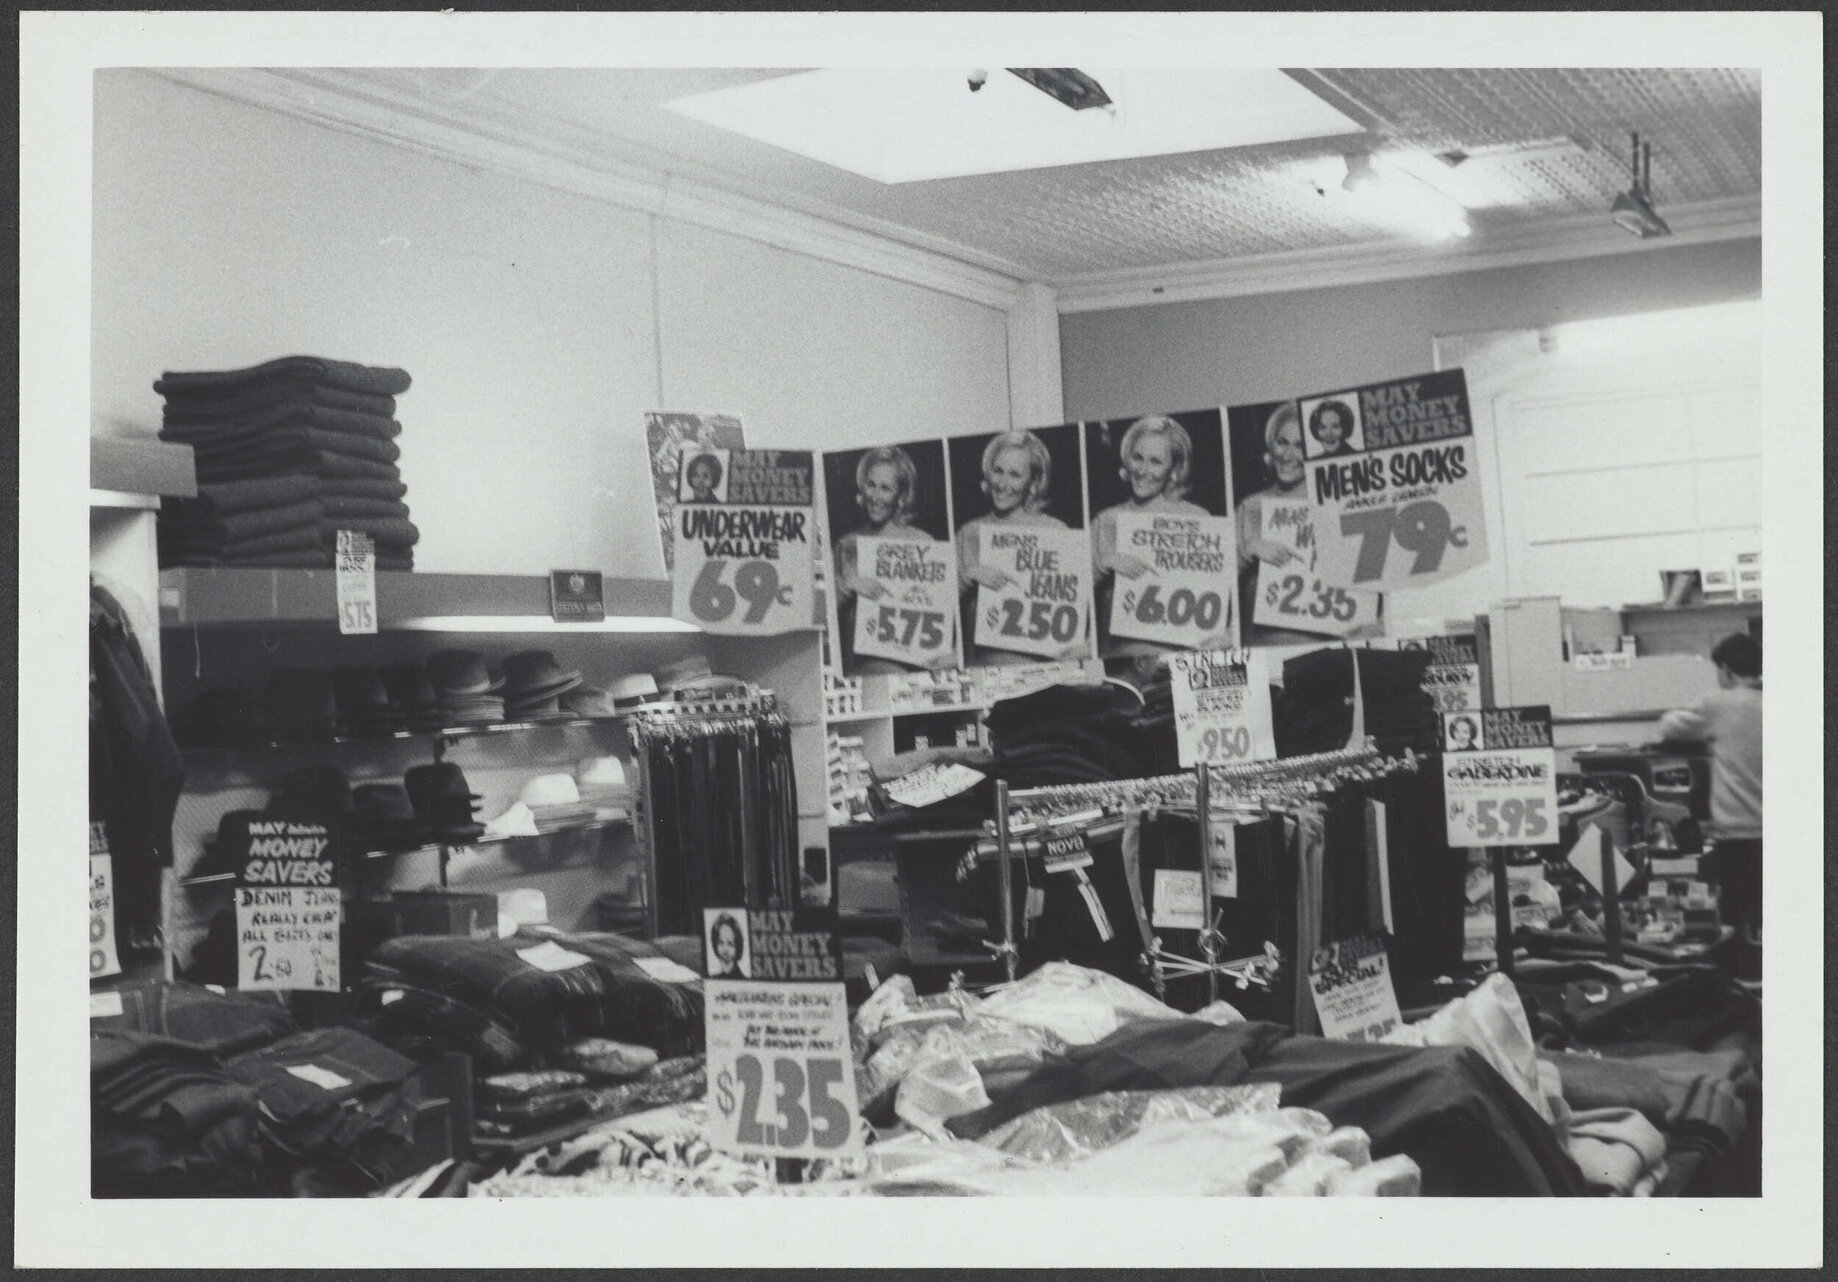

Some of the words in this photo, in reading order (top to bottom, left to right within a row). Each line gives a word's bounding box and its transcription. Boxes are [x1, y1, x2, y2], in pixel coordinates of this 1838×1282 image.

[1361, 382, 1420, 409] MAY
[1364, 395, 1460, 427] MONEY
[1366, 414, 1467, 447] SAVERS
[731, 451, 778, 468] MAY
[1390, 445, 1467, 487] SOCKS
[731, 467, 808, 487] MONEY
[730, 486, 809, 503] SAVERS
[682, 509, 807, 544] UNDERWEAR
[703, 540, 780, 560] VALUE
[1131, 529, 1221, 549] STRETCH
[1339, 500, 1469, 584] 79c
[1015, 549, 1059, 572] BLUE
[1155, 550, 1223, 573] TROUSERS
[689, 560, 794, 625] 69c
[1024, 574, 1079, 603] JEANS
[1123, 585, 1222, 630] $6.00
[866, 605, 946, 650] $5.75
[1484, 710, 1522, 725] MAY
[1484, 721, 1548, 737] MONEY
[1485, 735, 1550, 750] SAVERS
[248, 822, 285, 836] MAY
[249, 836, 328, 859] MONEY
[1047, 835, 1085, 855] NOVA
[244, 859, 333, 886] SAVERS
[240, 889, 292, 907] DENIM
[751, 910, 795, 932] MAY
[751, 932, 832, 956] MONEY
[751, 955, 838, 979] SAVERS
[716, 1053, 851, 1148] $2.35
